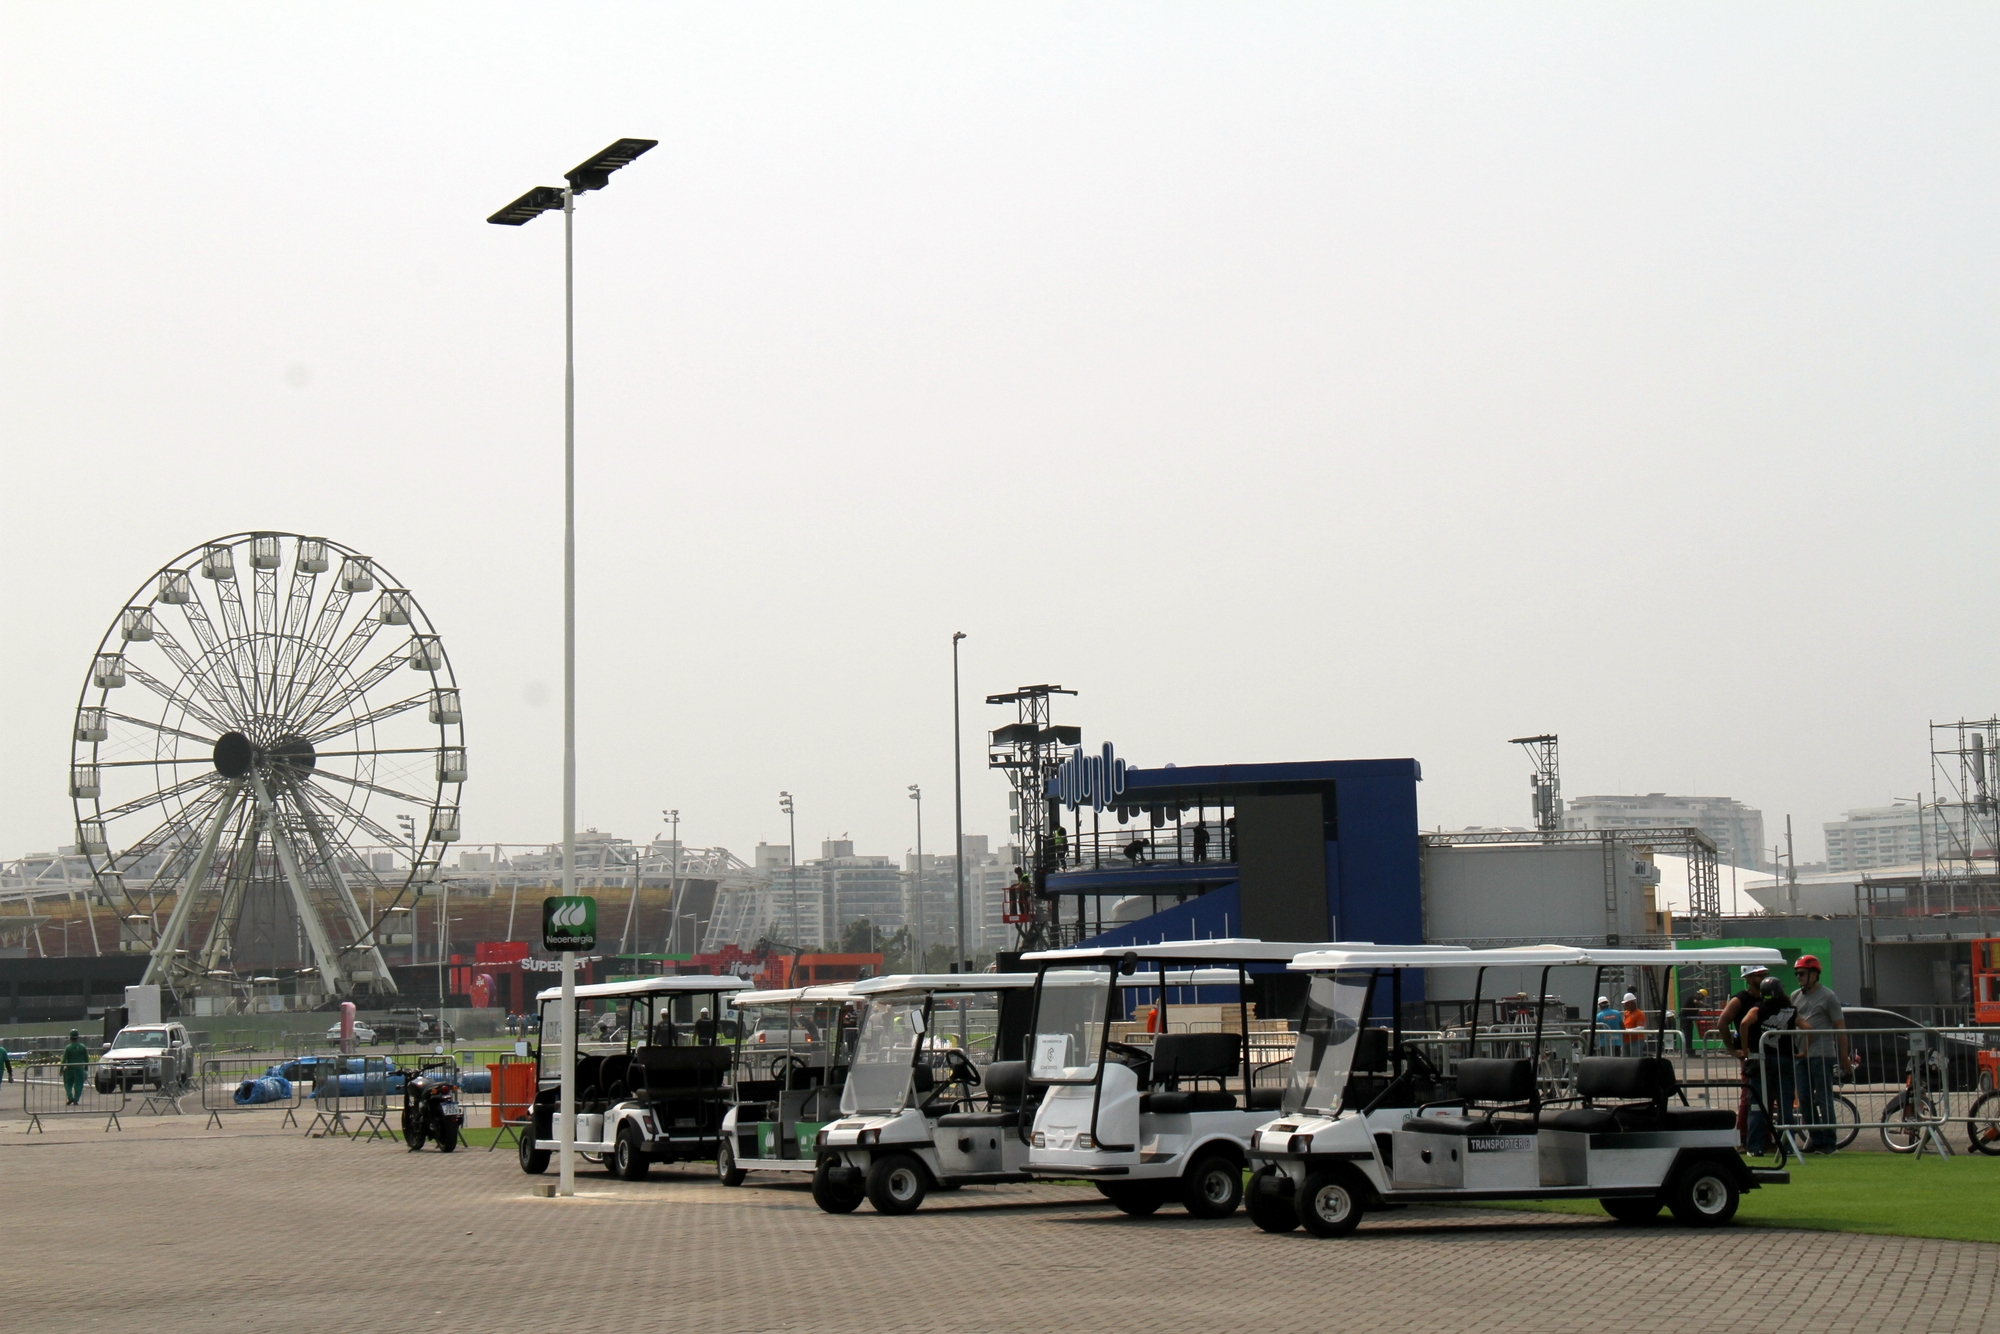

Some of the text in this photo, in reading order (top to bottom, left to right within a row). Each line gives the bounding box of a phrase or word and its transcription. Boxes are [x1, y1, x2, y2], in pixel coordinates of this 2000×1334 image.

[546, 935, 593, 944] Neoenergia
[521, 957, 587, 972] SUPERET
[729, 960, 766, 976] ifood
[1470, 1138, 1530, 1149] TRANSPORTER 6
